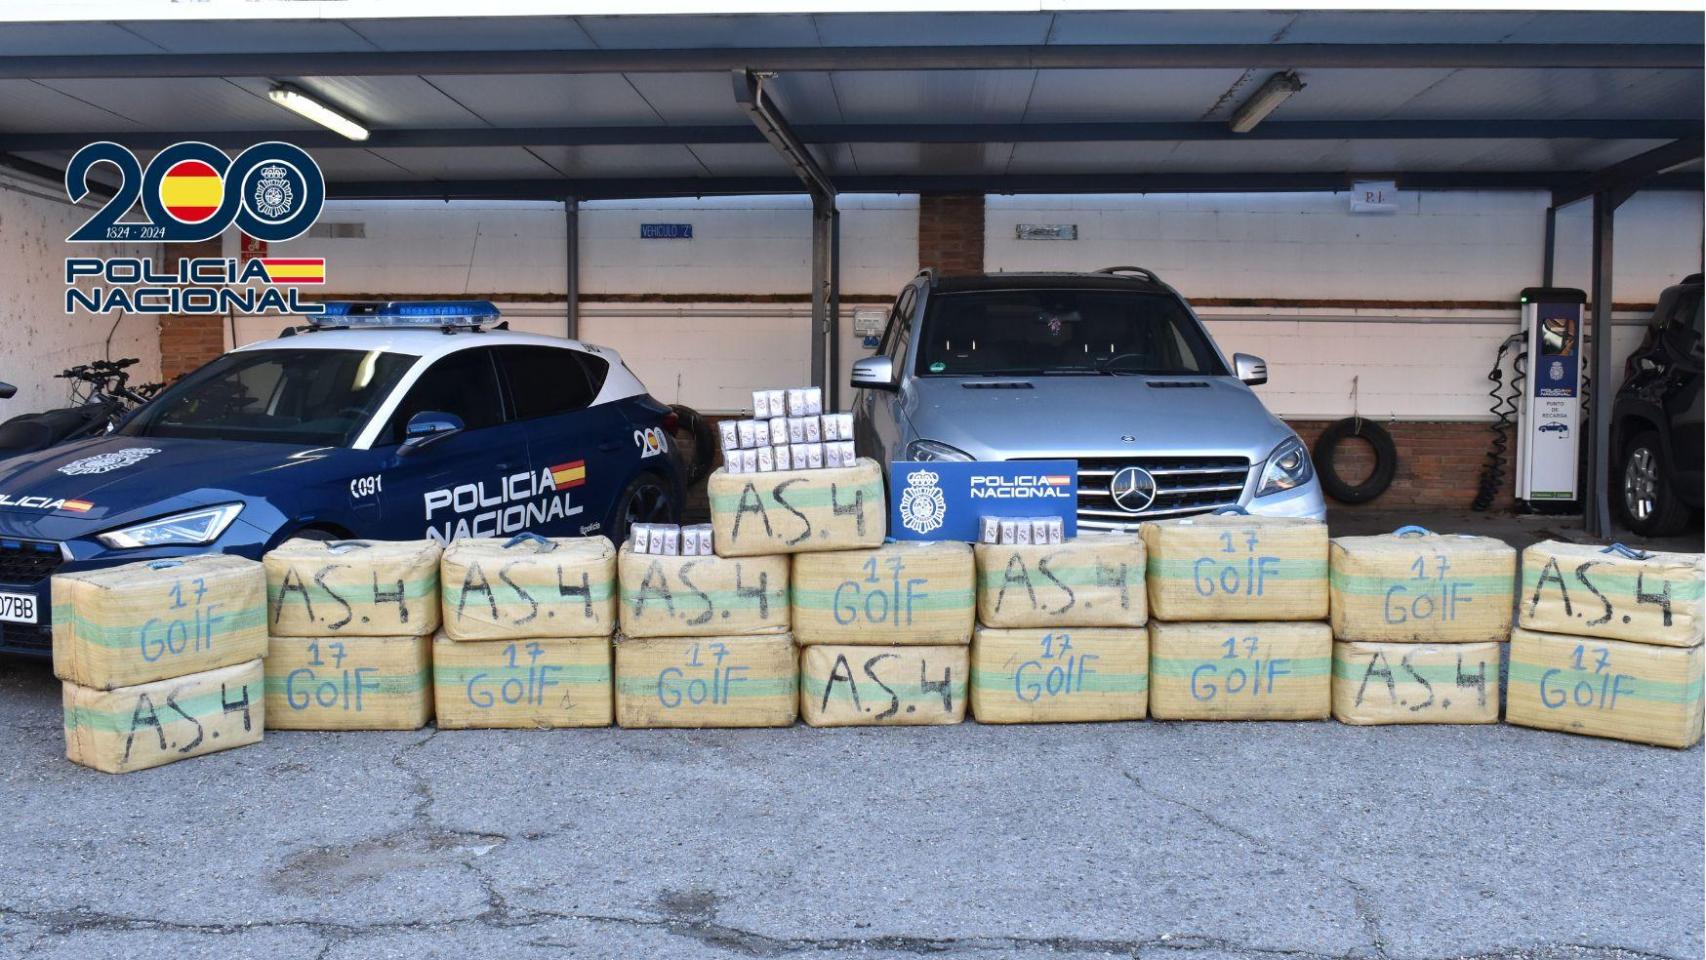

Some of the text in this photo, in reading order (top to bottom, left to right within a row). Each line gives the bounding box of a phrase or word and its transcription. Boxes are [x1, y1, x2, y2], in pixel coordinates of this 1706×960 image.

[634, 427, 668, 458] 200
[970, 476, 1050, 487] POLICIA
[970, 487, 1070, 498] NACIONAL
[425, 492, 584, 547] NACIONAL
[1220, 530, 1259, 552] 17
[863, 556, 906, 583] 17
[1410, 555, 1451, 581] 17
[168, 576, 208, 610] 17
[307, 639, 348, 669] 17
[502, 641, 545, 669] 17
[684, 642, 731, 667] 17
[1041, 633, 1073, 660] 17
[1221, 636, 1259, 660] 17
[1569, 645, 1612, 674] 17
